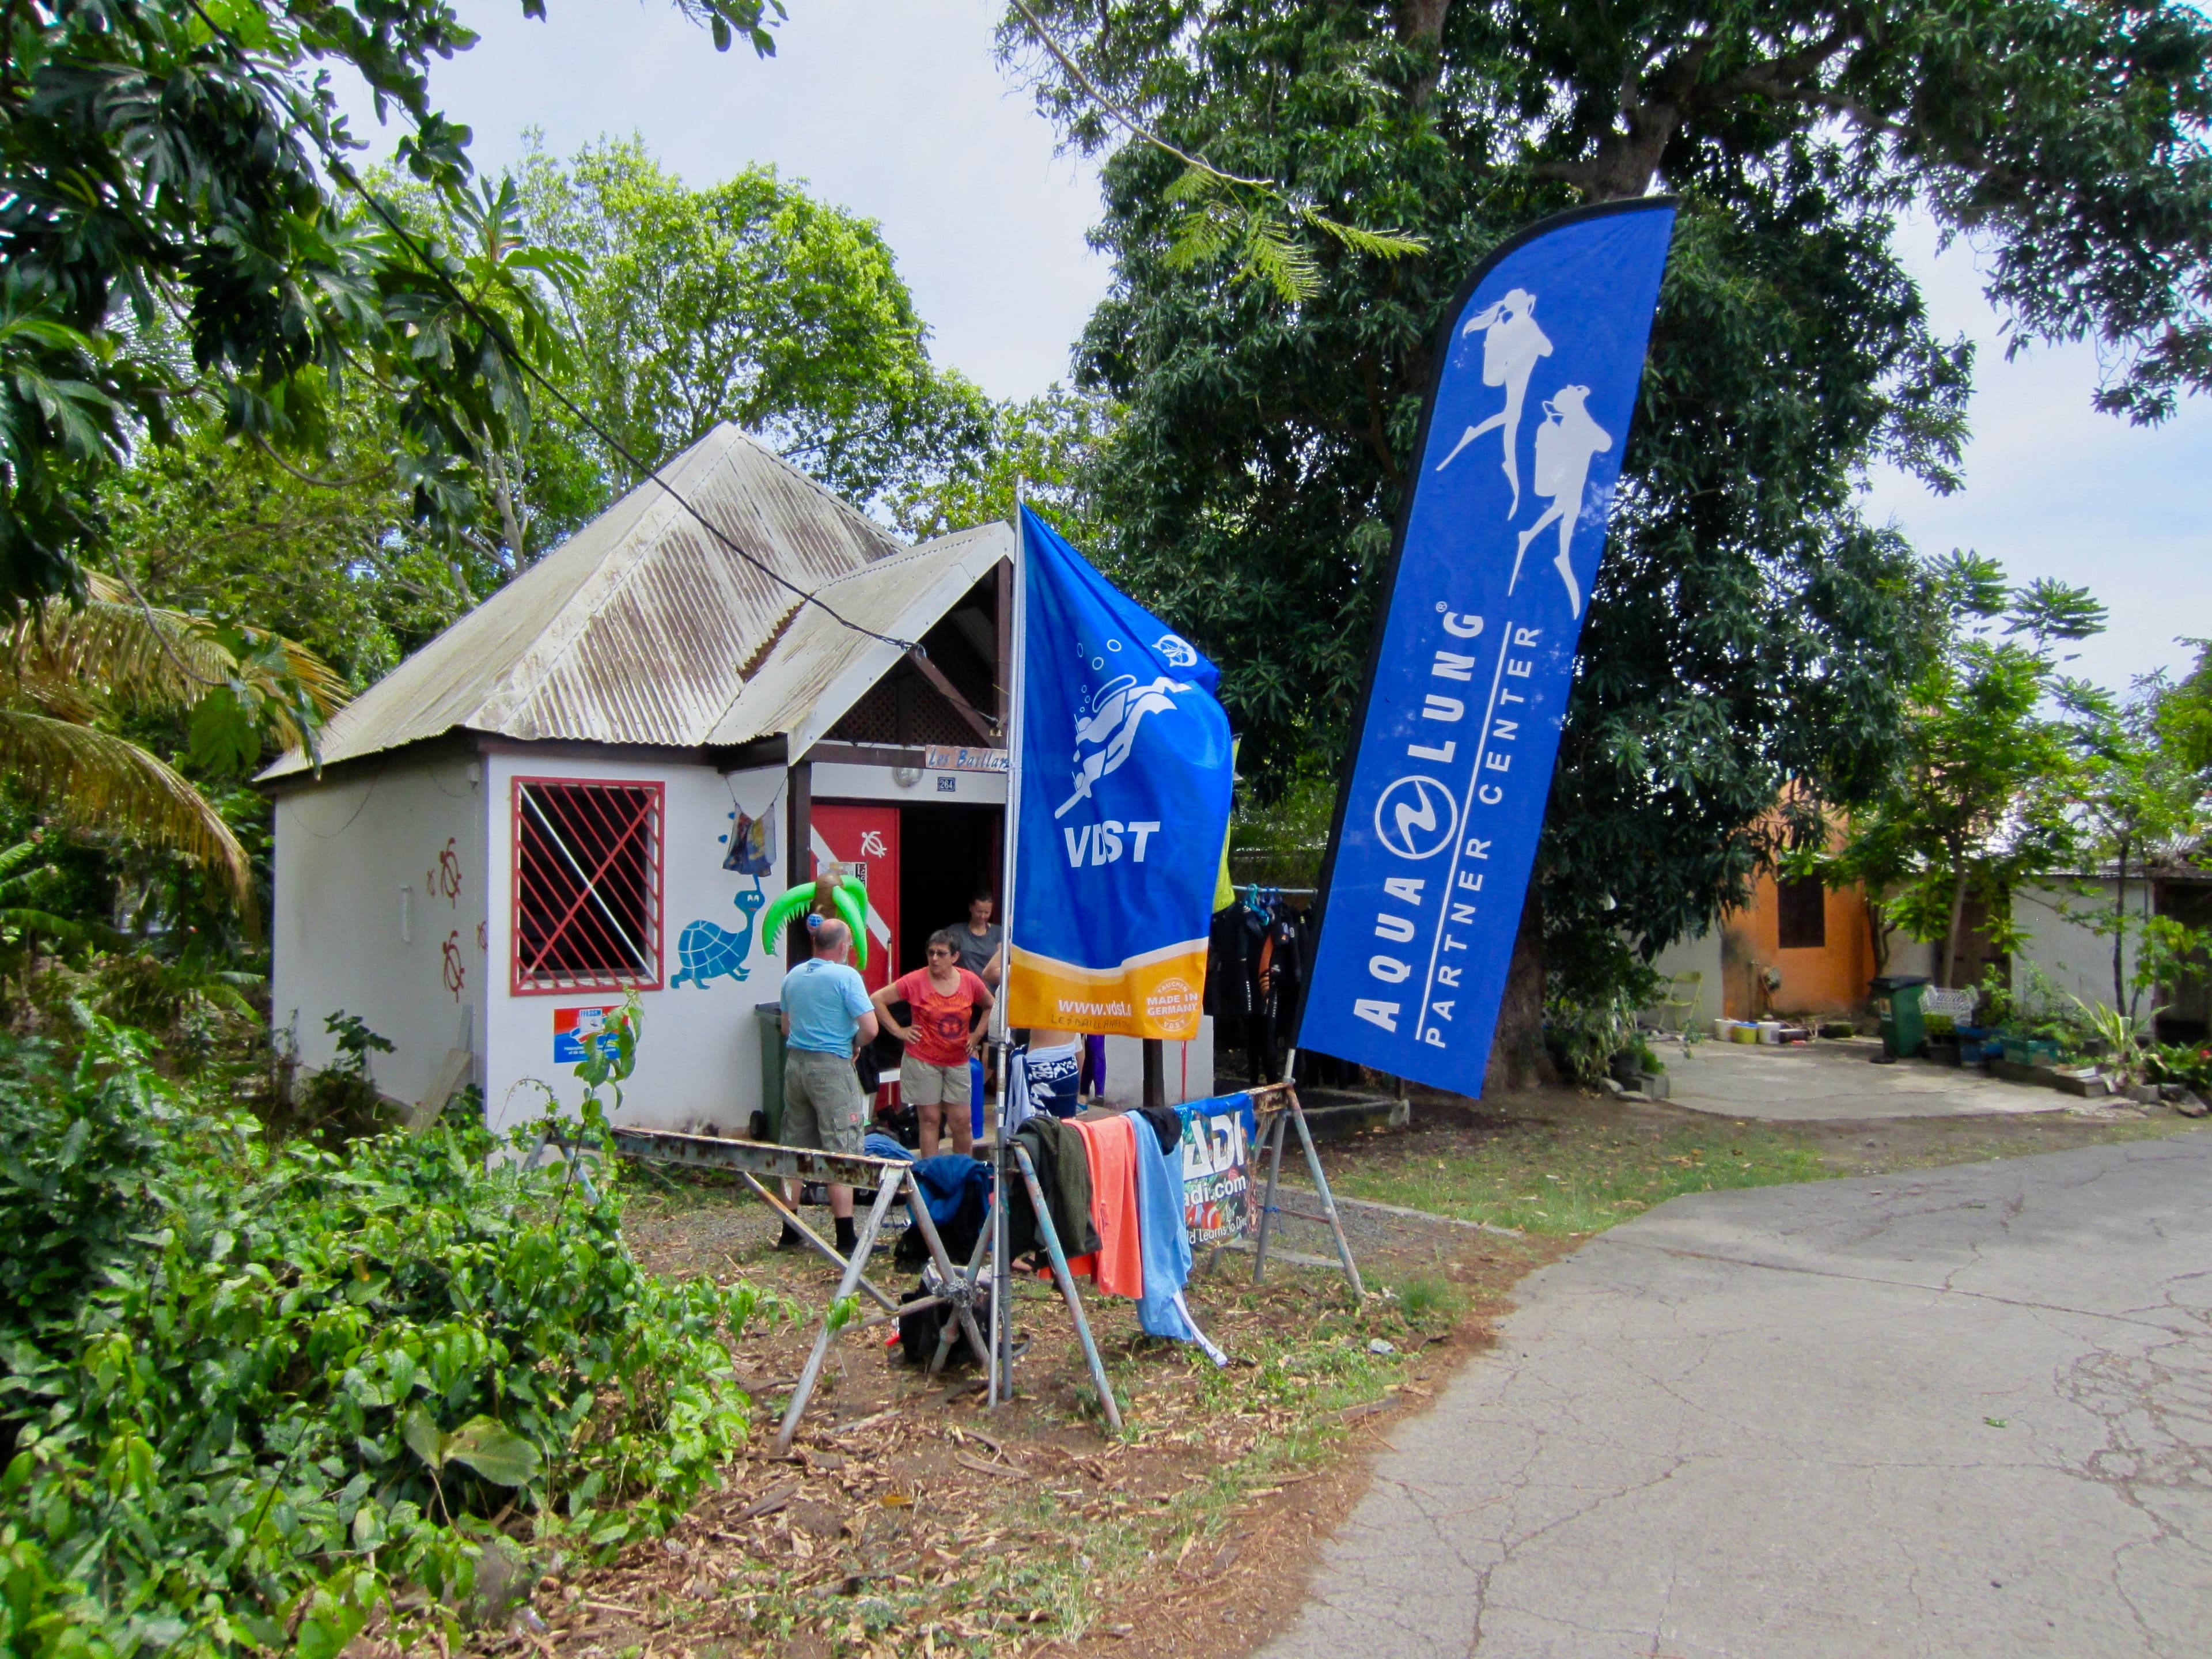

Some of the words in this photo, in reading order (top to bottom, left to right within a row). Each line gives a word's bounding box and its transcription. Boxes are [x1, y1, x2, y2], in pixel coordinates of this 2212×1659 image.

[928, 748, 949, 766] Les
[939, 779, 953, 789] 264
[1353, 878, 1426, 1033] AQUA
[1407, 611, 1484, 764] LUNG
[1064, 820, 1161, 868] VDST
[1425, 837, 1492, 1049] PARTNER
[1479, 627, 1540, 805] CENTER
[1147, 995, 1180, 1005] MADE
[1184, 993, 1198, 1002] IN
[1147, 1003, 1198, 1016] GERMANY
[1164, 1018, 1185, 1029] VDST
[1180, 1111, 1244, 1181] ADI
[1199, 1226, 1227, 1242] Learns
[1228, 1219, 1236, 1233] To
